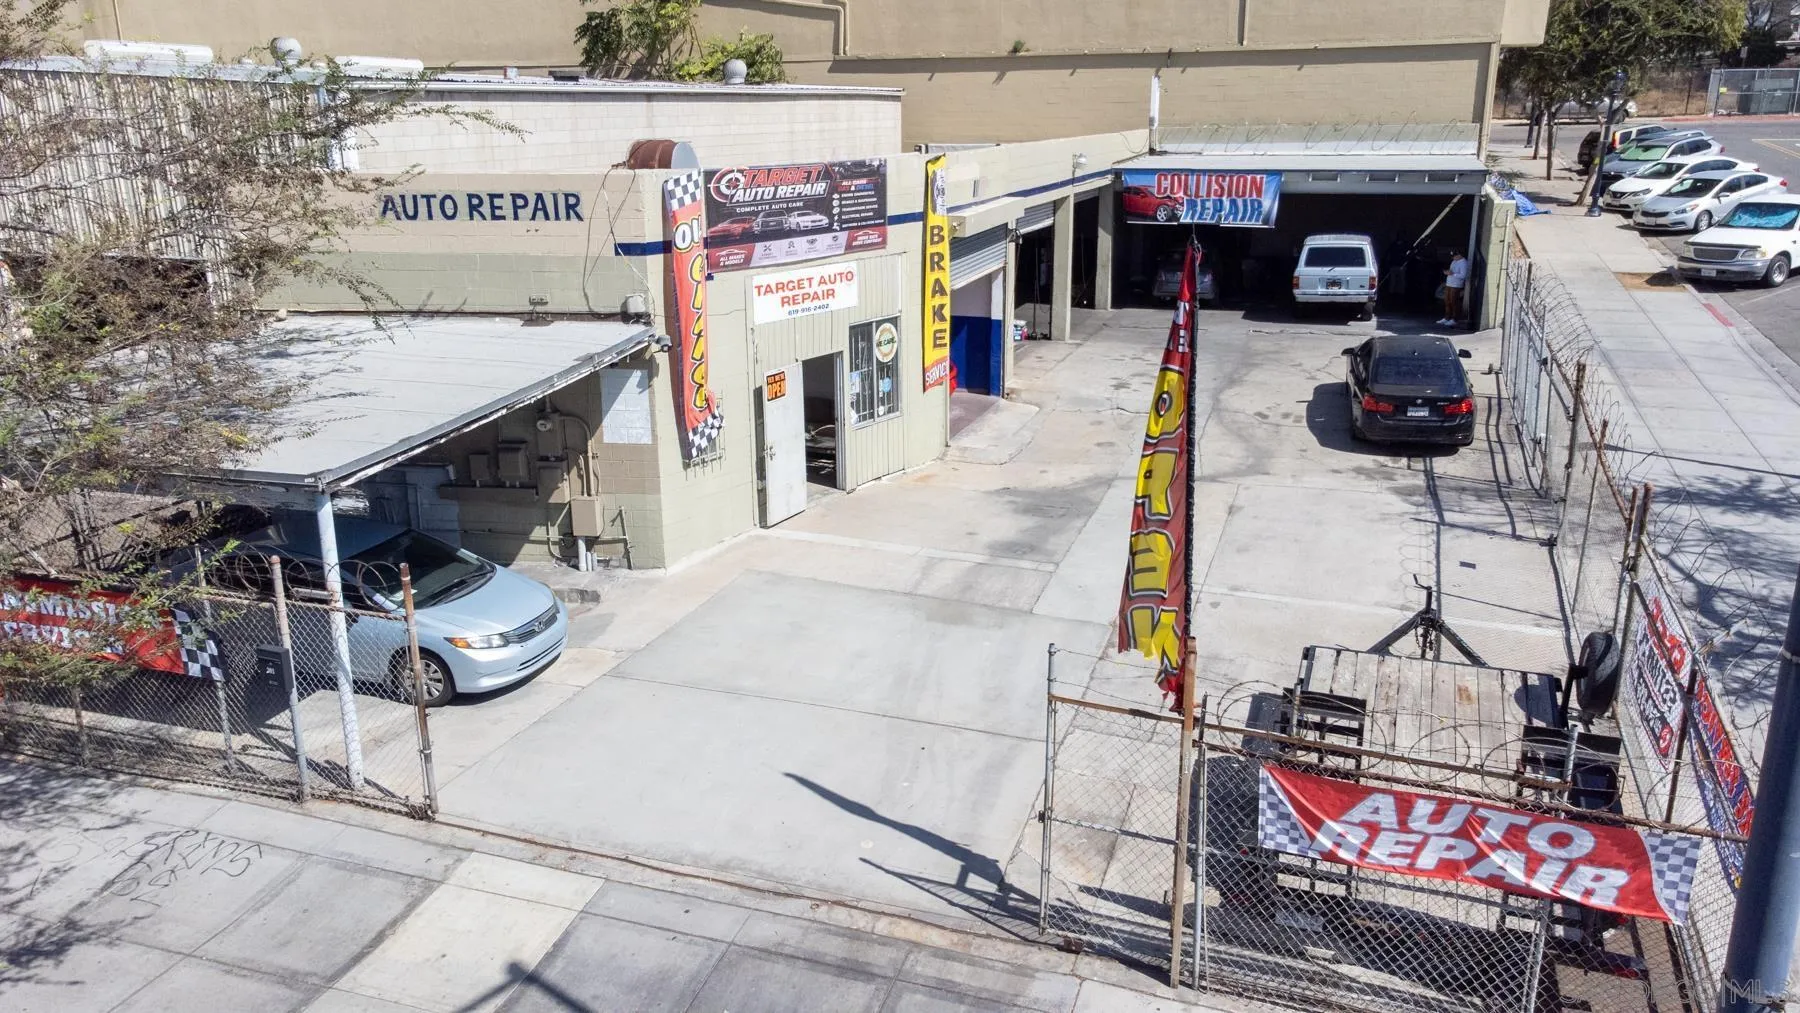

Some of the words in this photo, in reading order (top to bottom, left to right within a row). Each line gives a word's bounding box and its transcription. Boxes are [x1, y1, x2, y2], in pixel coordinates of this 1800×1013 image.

[743, 167, 822, 188] TARGET
[1155, 172, 1266, 199] COLLISION
[732, 187, 775, 203] AUTO
[776, 182, 827, 202] REPAIR
[381, 193, 458, 221] AUTO
[466, 192, 584, 222] REPAIR
[736, 205, 770, 213] COMPLETE
[1180, 197, 1263, 224] REPAIR
[673, 214, 702, 251] OI
[754, 277, 814, 297] TARGET
[818, 271, 854, 287] AUTO
[929, 224, 948, 349] BRAKE
[780, 288, 836, 308] REPAIR
[768, 381, 785, 400] OPEN
[1337, 792, 1597, 860] AUTO
[1309, 821, 1630, 905] REPAIR
